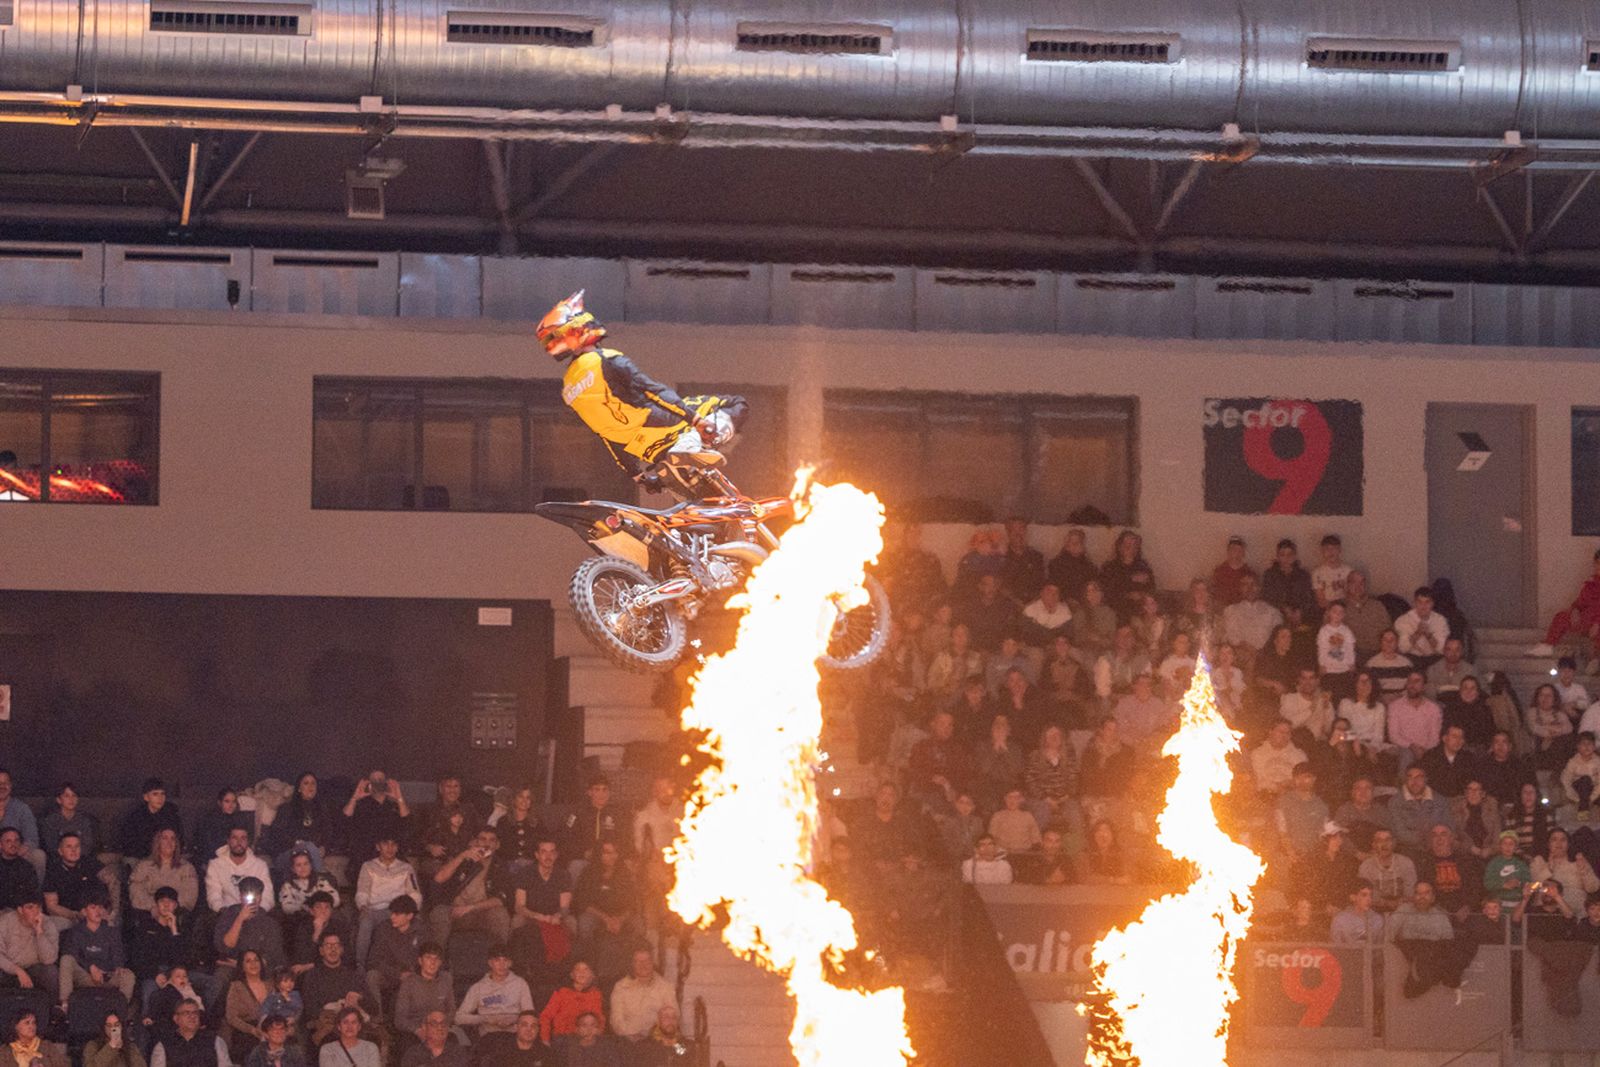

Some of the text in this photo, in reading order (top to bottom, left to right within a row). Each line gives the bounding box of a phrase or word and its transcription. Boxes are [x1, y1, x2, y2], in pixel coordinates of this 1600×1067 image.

[1203, 399, 1333, 515] Sector 9
[1254, 947, 1342, 1028] Sector 9
